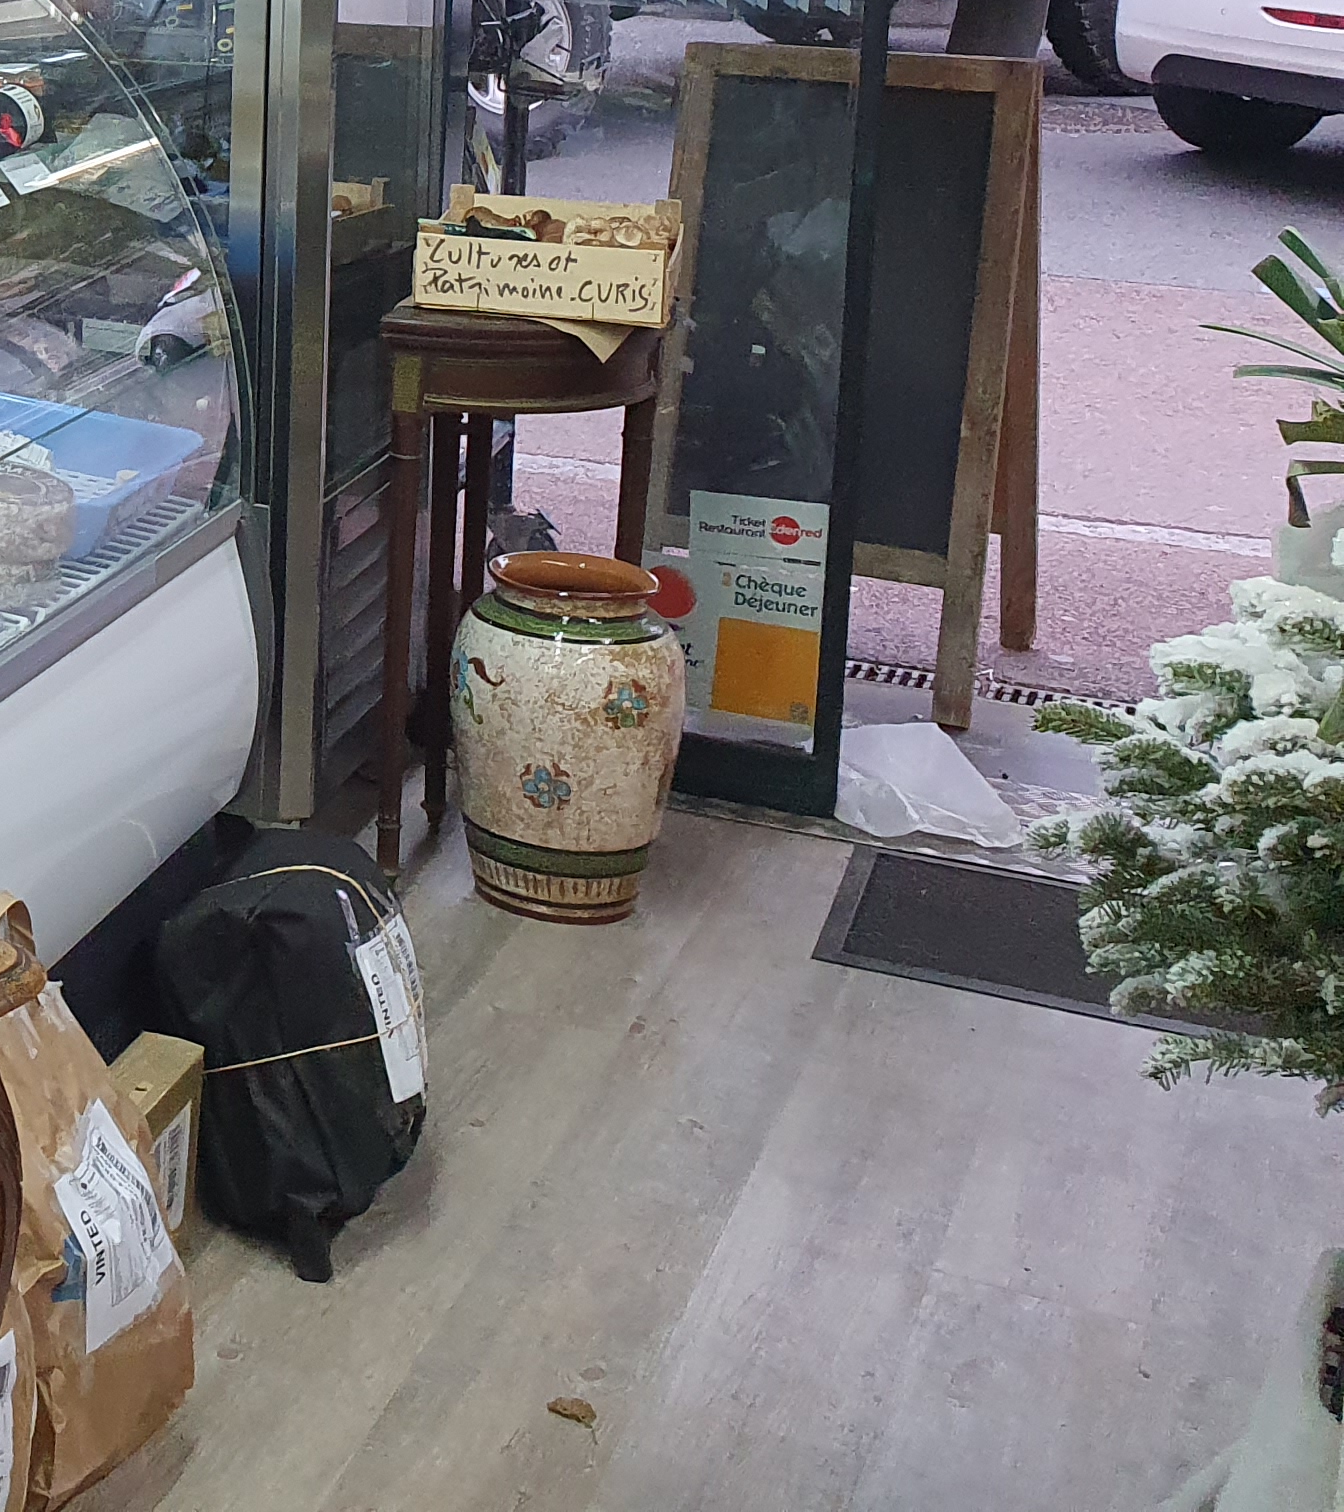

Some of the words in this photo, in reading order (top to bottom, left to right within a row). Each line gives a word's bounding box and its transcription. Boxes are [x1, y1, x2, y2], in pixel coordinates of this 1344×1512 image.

[698, 520, 766, 539] Restaurant
[731, 514, 767, 528] Ticket
[735, 574, 808, 598] Chèque
[733, 591, 819, 618] Déjeuner
[79, 1209, 109, 1286] VINTED
